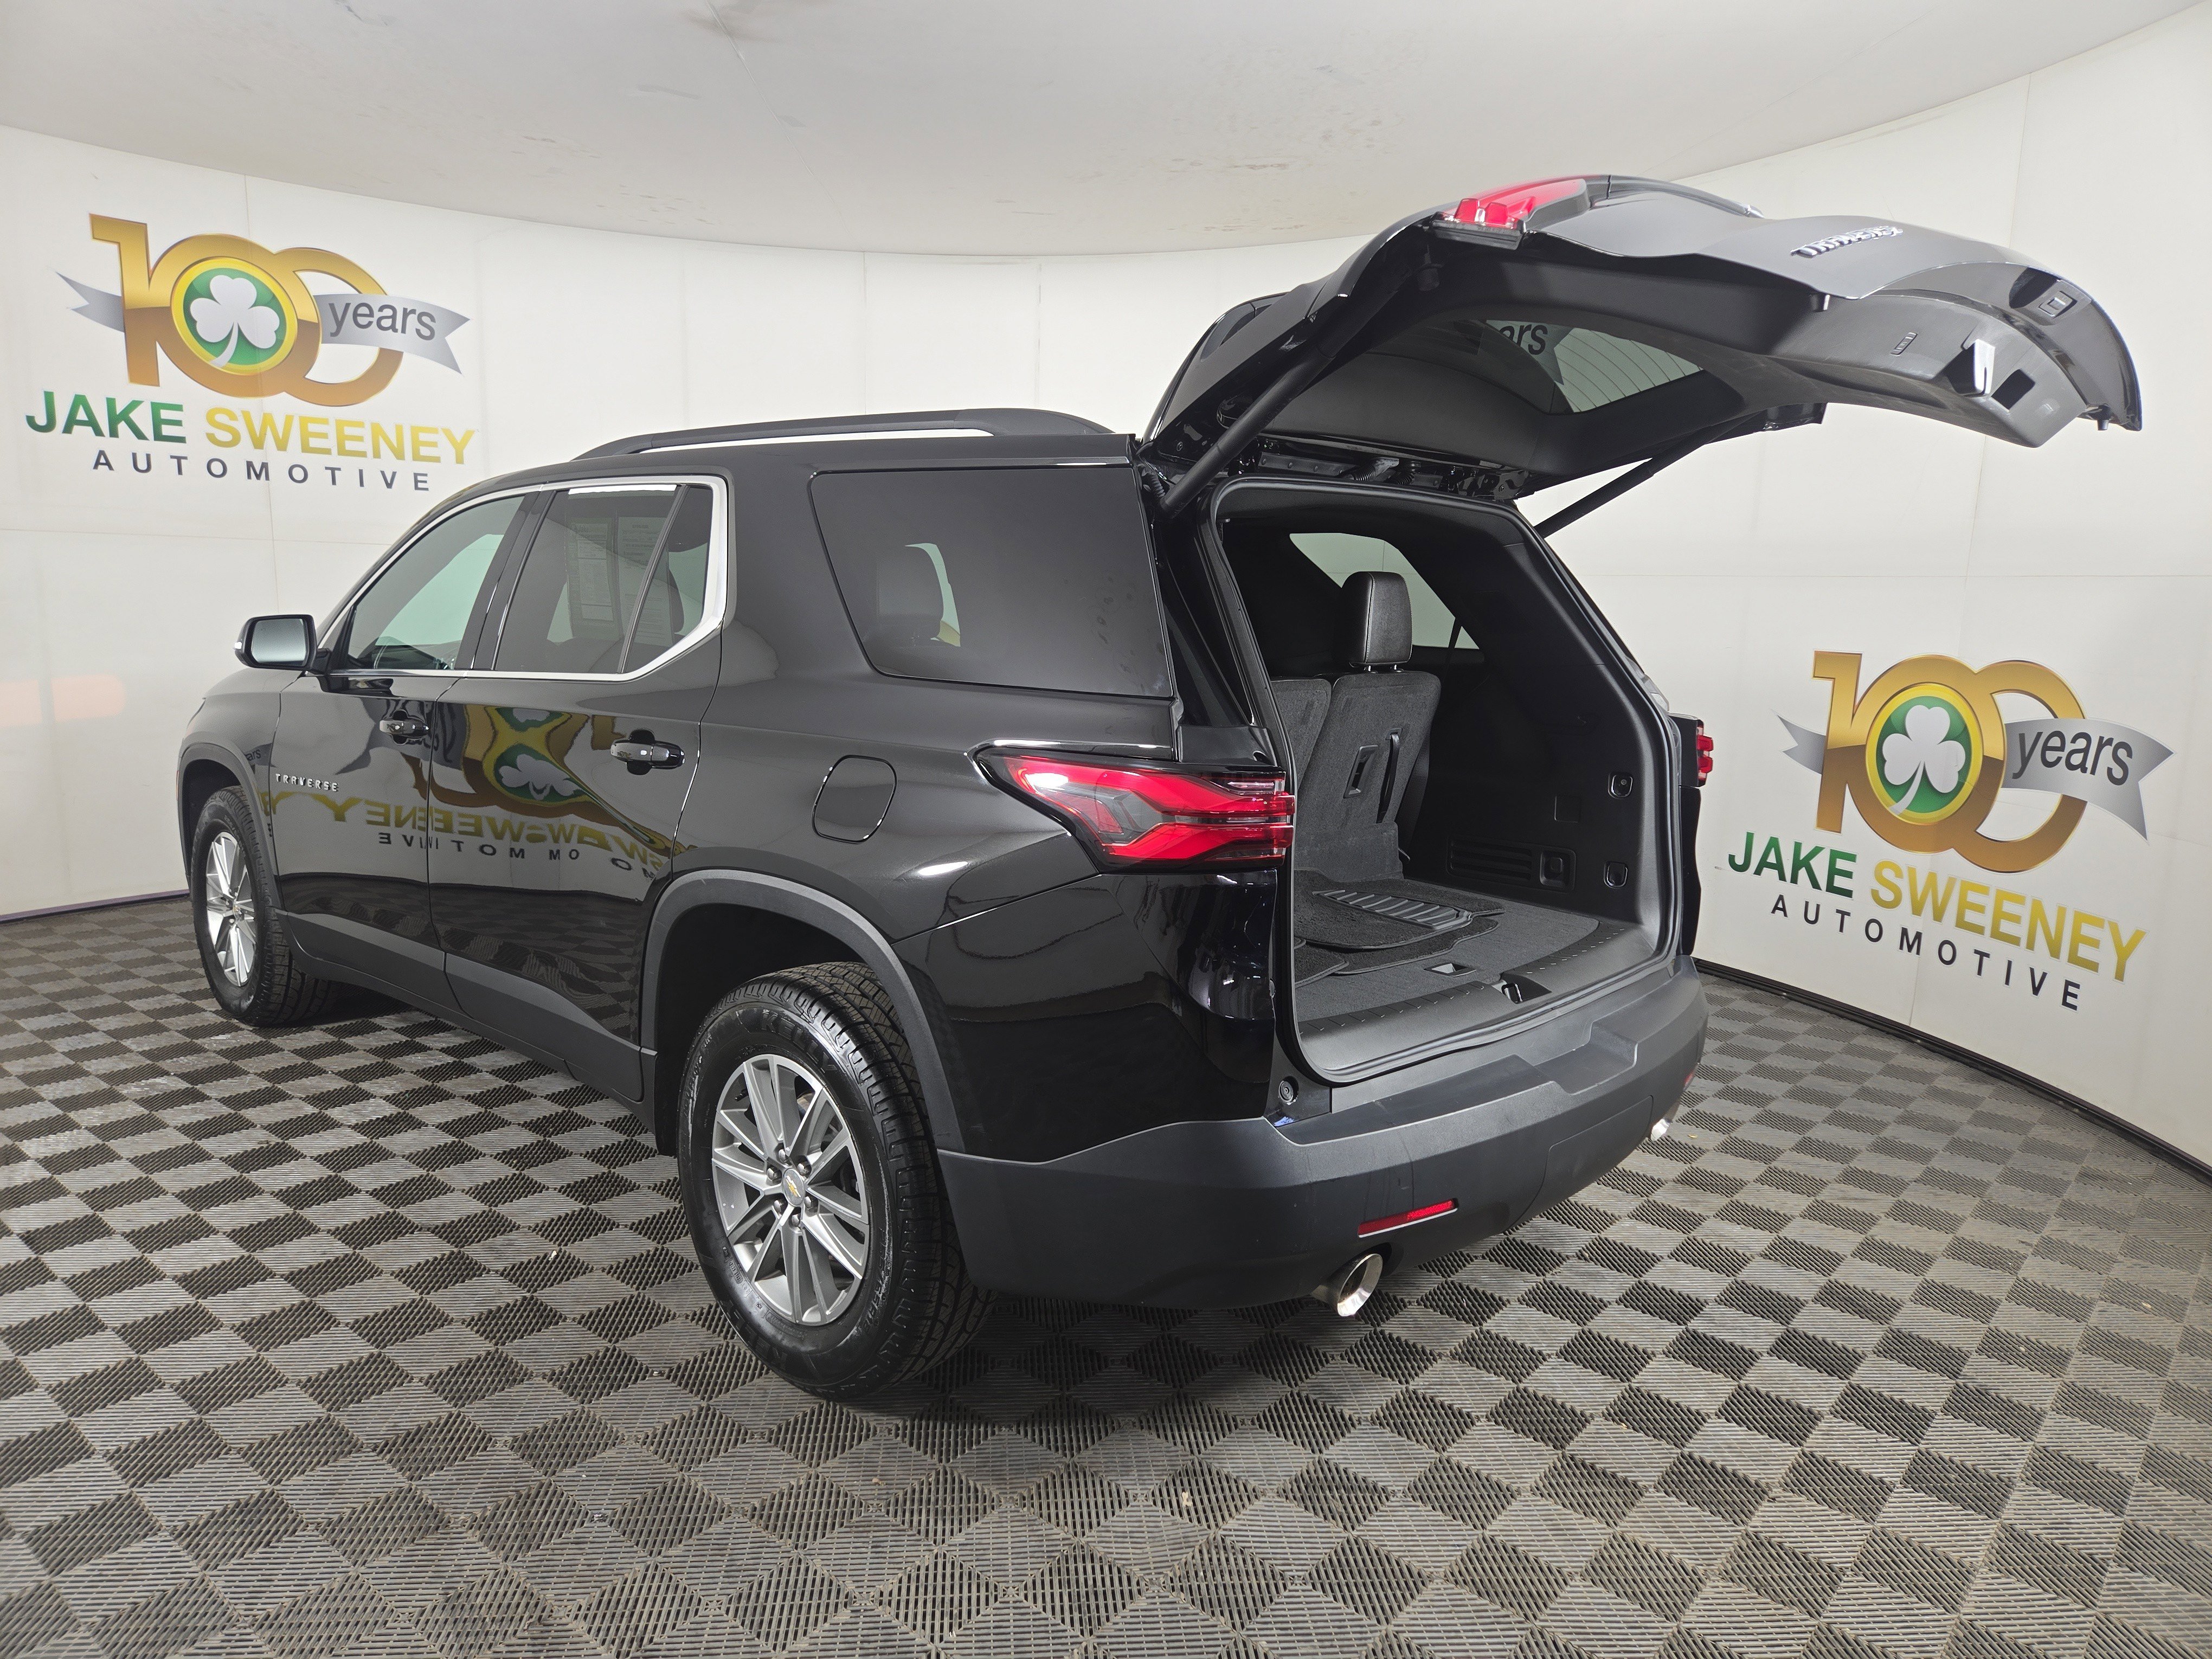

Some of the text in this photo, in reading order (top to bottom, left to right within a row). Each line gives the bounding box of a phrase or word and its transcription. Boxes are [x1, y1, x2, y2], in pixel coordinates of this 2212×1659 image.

[89, 213, 436, 407] 100 years
[25, 390, 476, 465] JAKE SWEENEY
[93, 449, 430, 492] AUTOMOTIVE
[275, 773, 339, 792] TRAVERSE
[1812, 650, 2133, 874] 100 years
[1727, 831, 2146, 983] JAKE SWEENEY
[1771, 894, 2080, 1011] AUTOMOTIVE
[761, 1008, 838, 1073] KELLY
